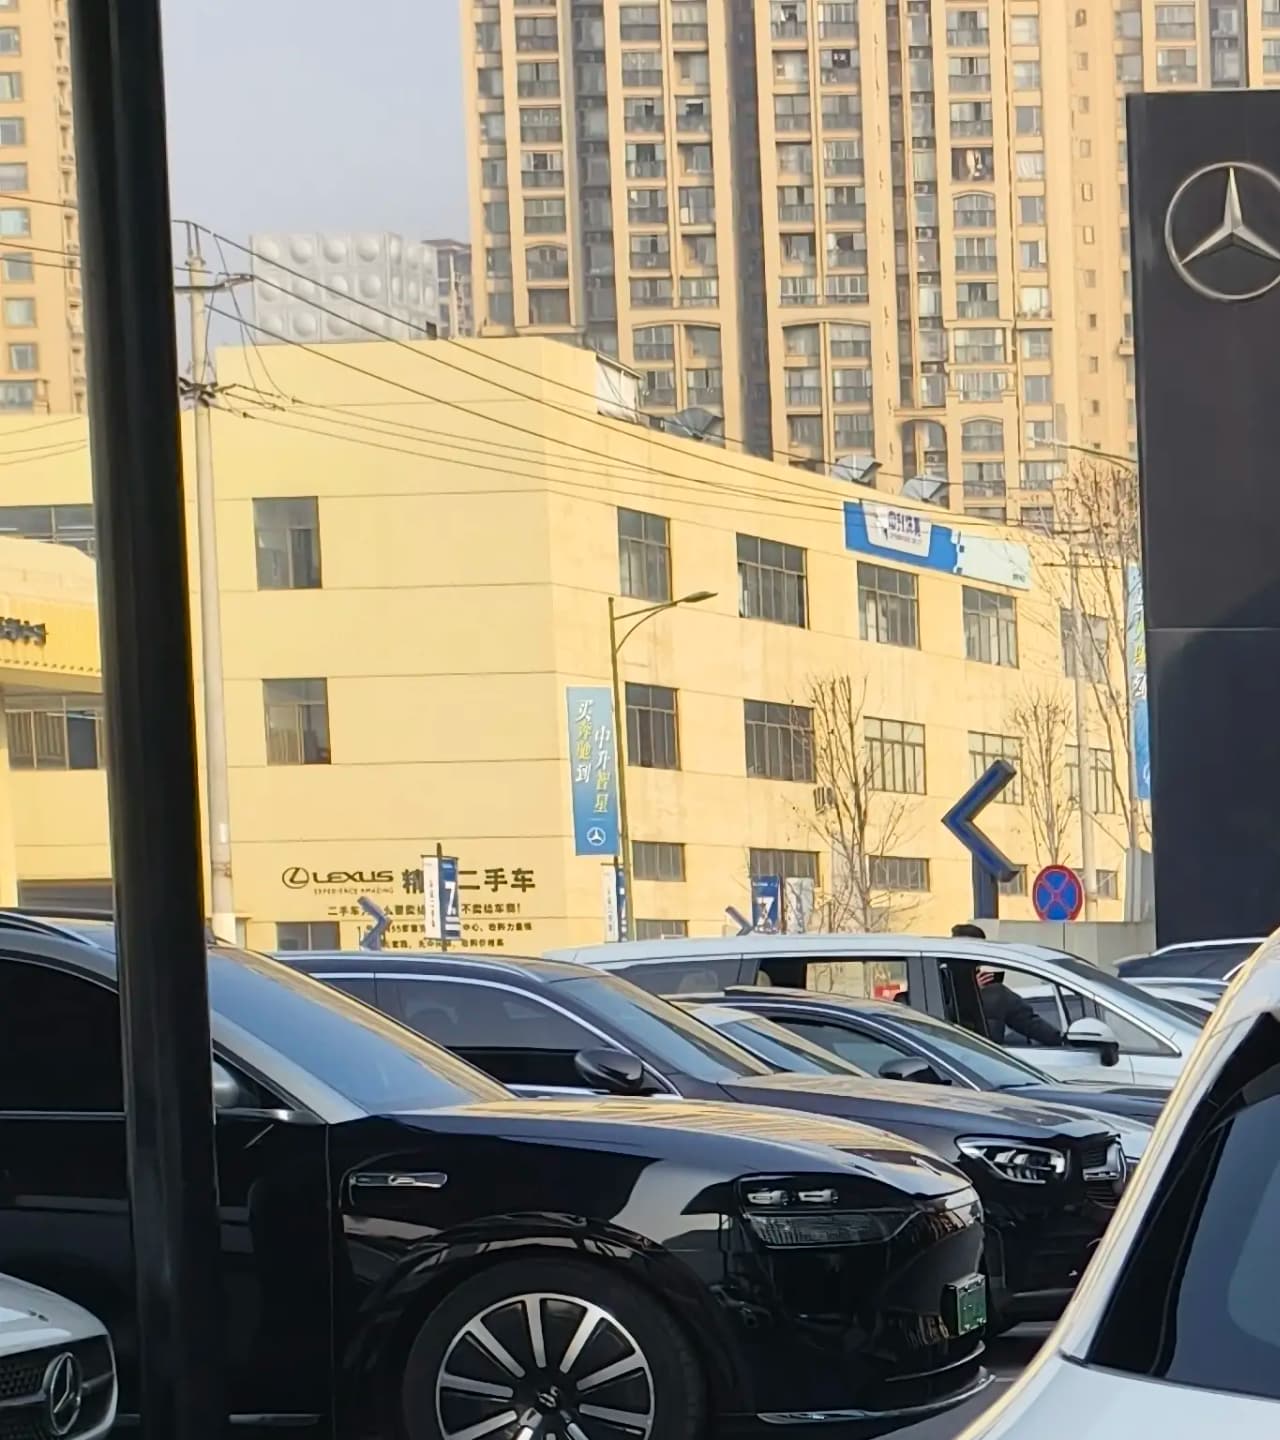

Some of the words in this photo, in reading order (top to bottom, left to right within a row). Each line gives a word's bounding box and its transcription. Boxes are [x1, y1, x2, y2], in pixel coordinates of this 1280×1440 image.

[312, 870, 394, 884] LEXUS
[402, 868, 536, 893] 精二手车
